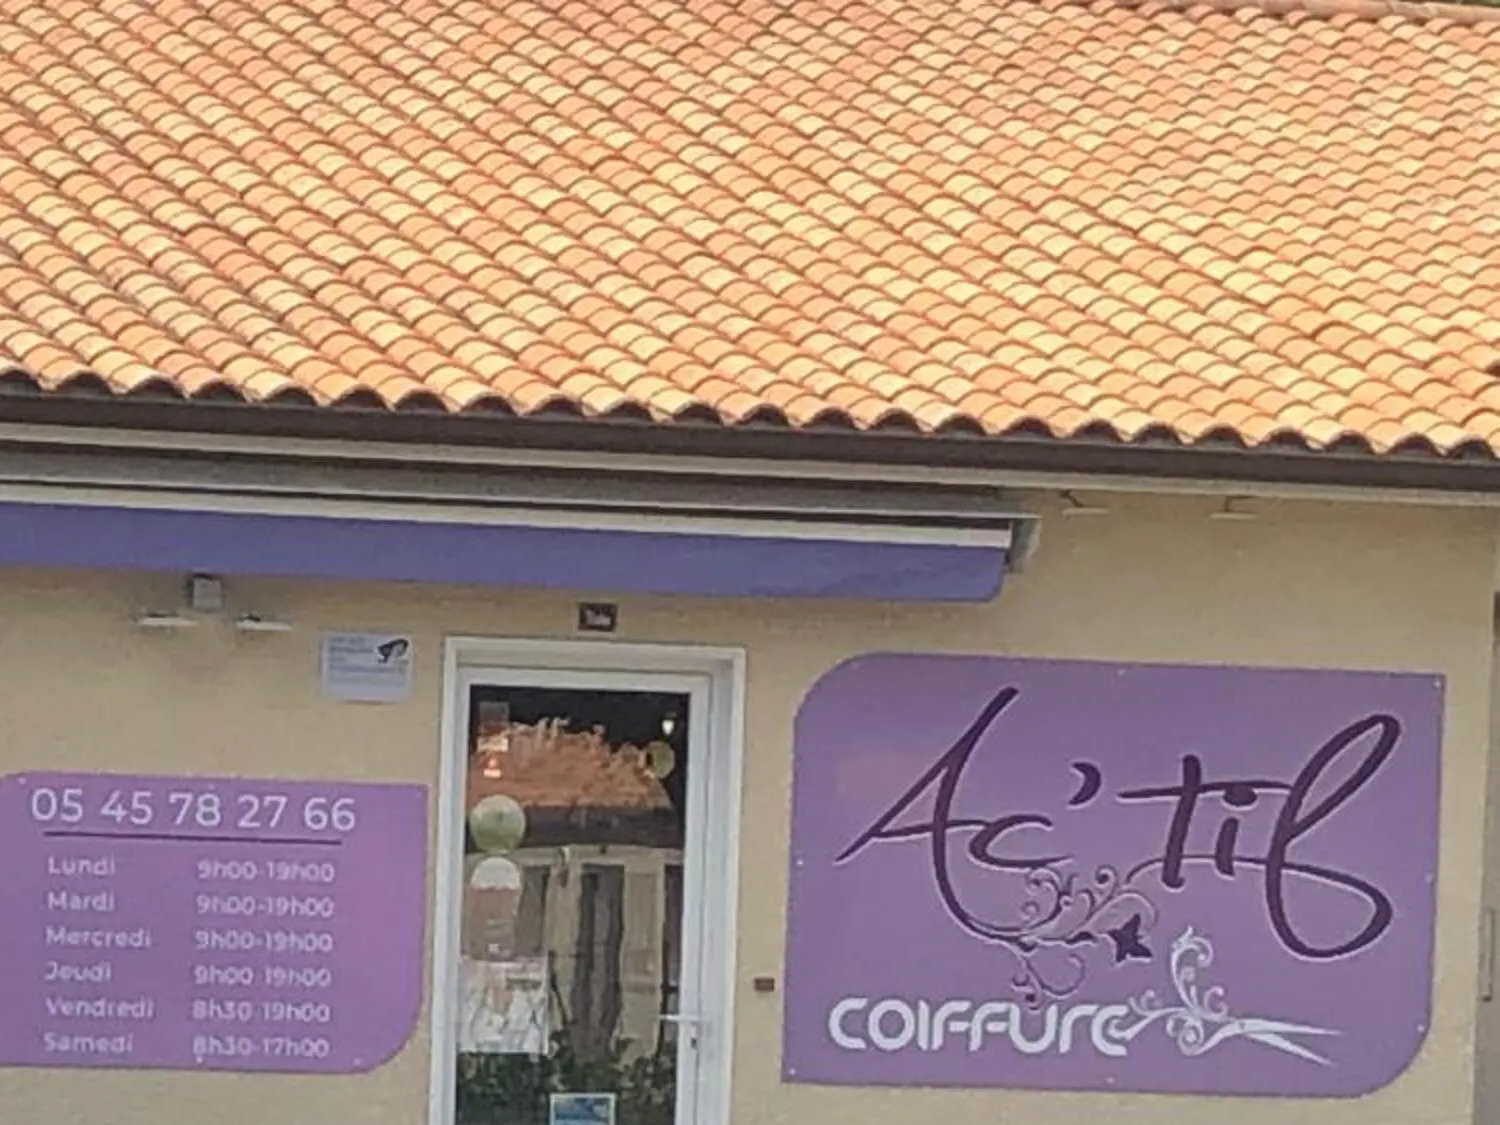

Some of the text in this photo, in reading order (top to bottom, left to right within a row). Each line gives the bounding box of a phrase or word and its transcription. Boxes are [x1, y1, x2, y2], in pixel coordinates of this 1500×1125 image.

[30, 787, 356, 831] 05 45 78 27 66
[48, 856, 336, 882] Lundi 9h00-19h00
[48, 890, 335, 918] Mardi 9h00-19h00
[45, 926, 334, 952] Mercredi 9h00-19h00
[44, 960, 333, 988] Jeudi 9h00-19h00
[45, 995, 331, 1023] Vendredi 8h30-19h00
[43, 1031, 330, 1058] Samedi 8h30-17h00
